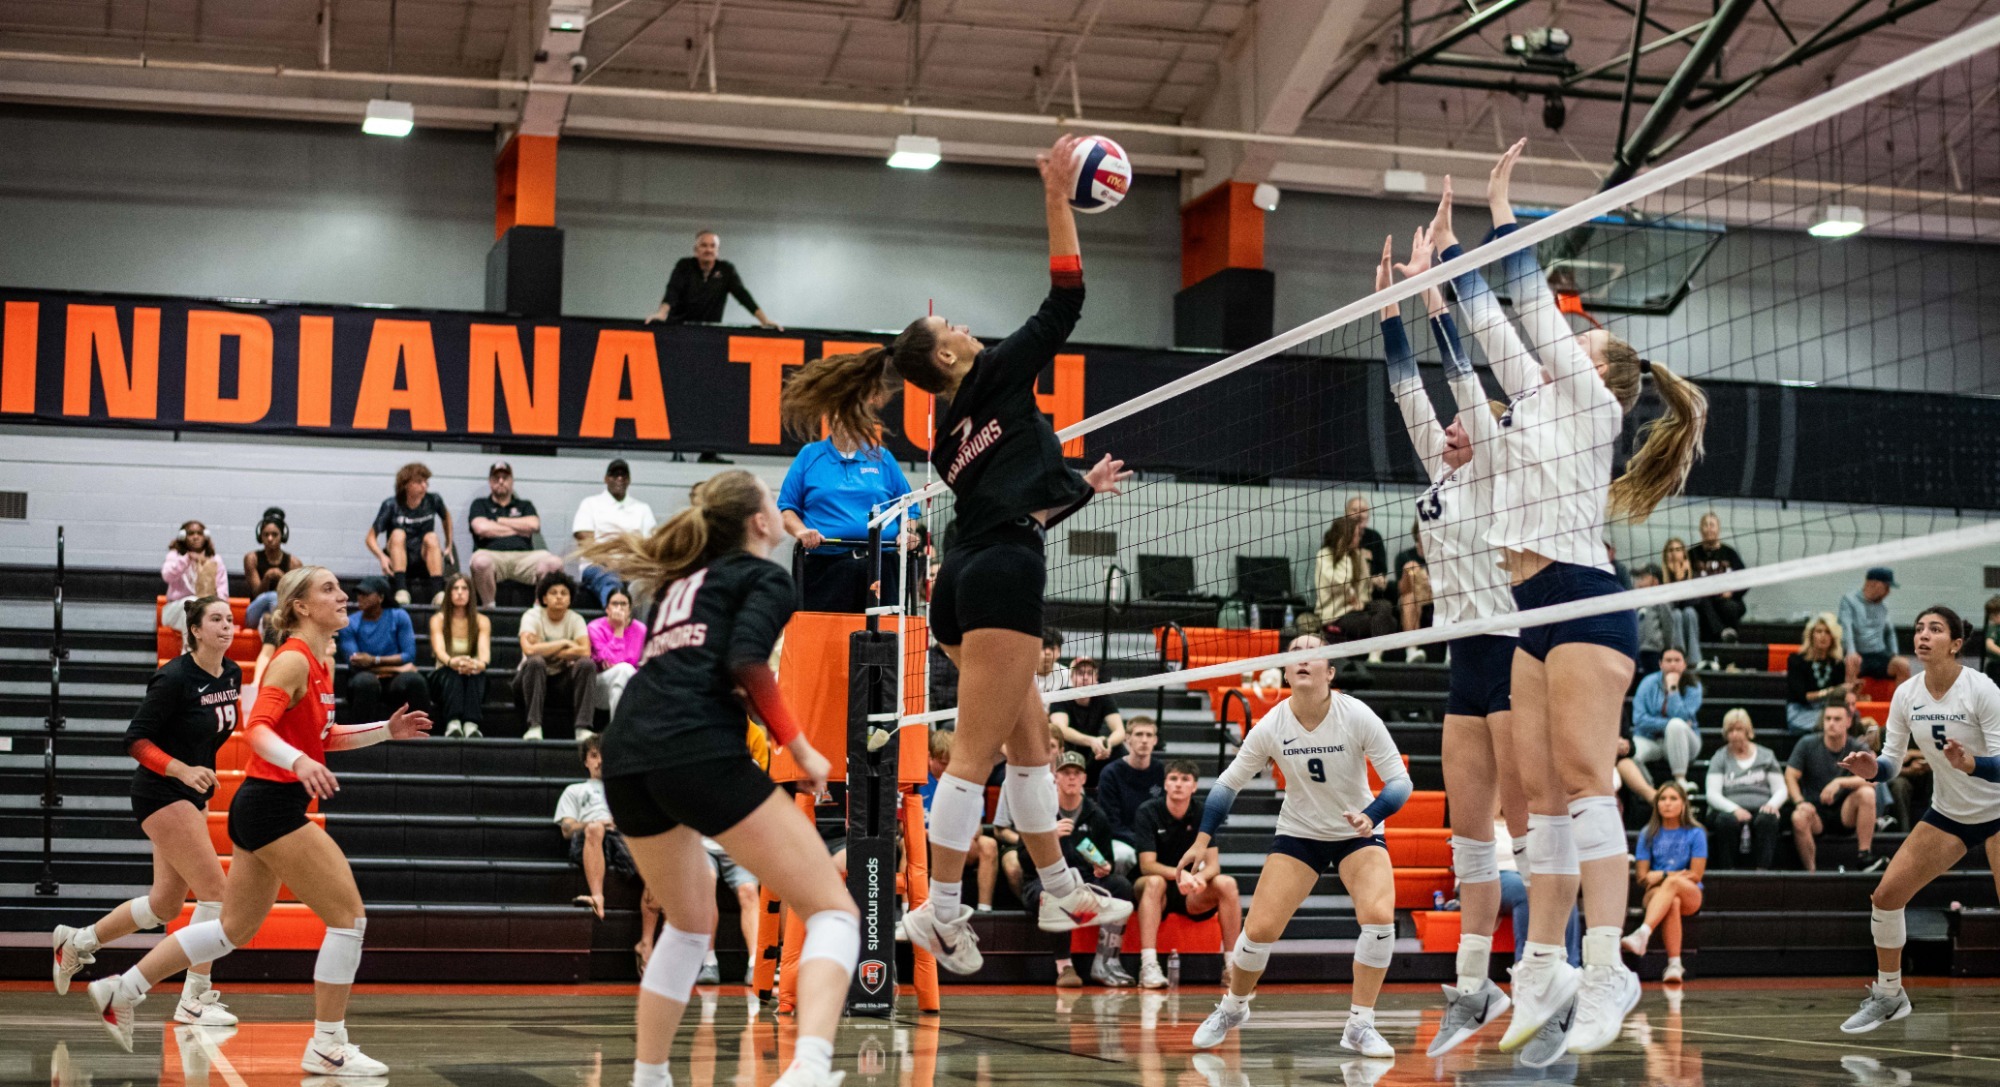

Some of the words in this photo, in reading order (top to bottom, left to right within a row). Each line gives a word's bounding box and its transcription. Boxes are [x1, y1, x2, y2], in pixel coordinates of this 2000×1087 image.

[1, 301, 671, 440] INDIANA
[728, 336, 1085, 458] TH
[653, 567, 708, 633] 10
[201, 689, 238, 705] INDIANATEC
[215, 704, 236, 732] 19
[1911, 713, 1966, 721] CORNERSTONE
[1283, 744, 1345, 755] CORNERSTONE
[1932, 725, 1948, 750] 5
[1308, 758, 1326, 783] 9
[866, 857, 879, 899] sports
[866, 901, 879, 951] imports
